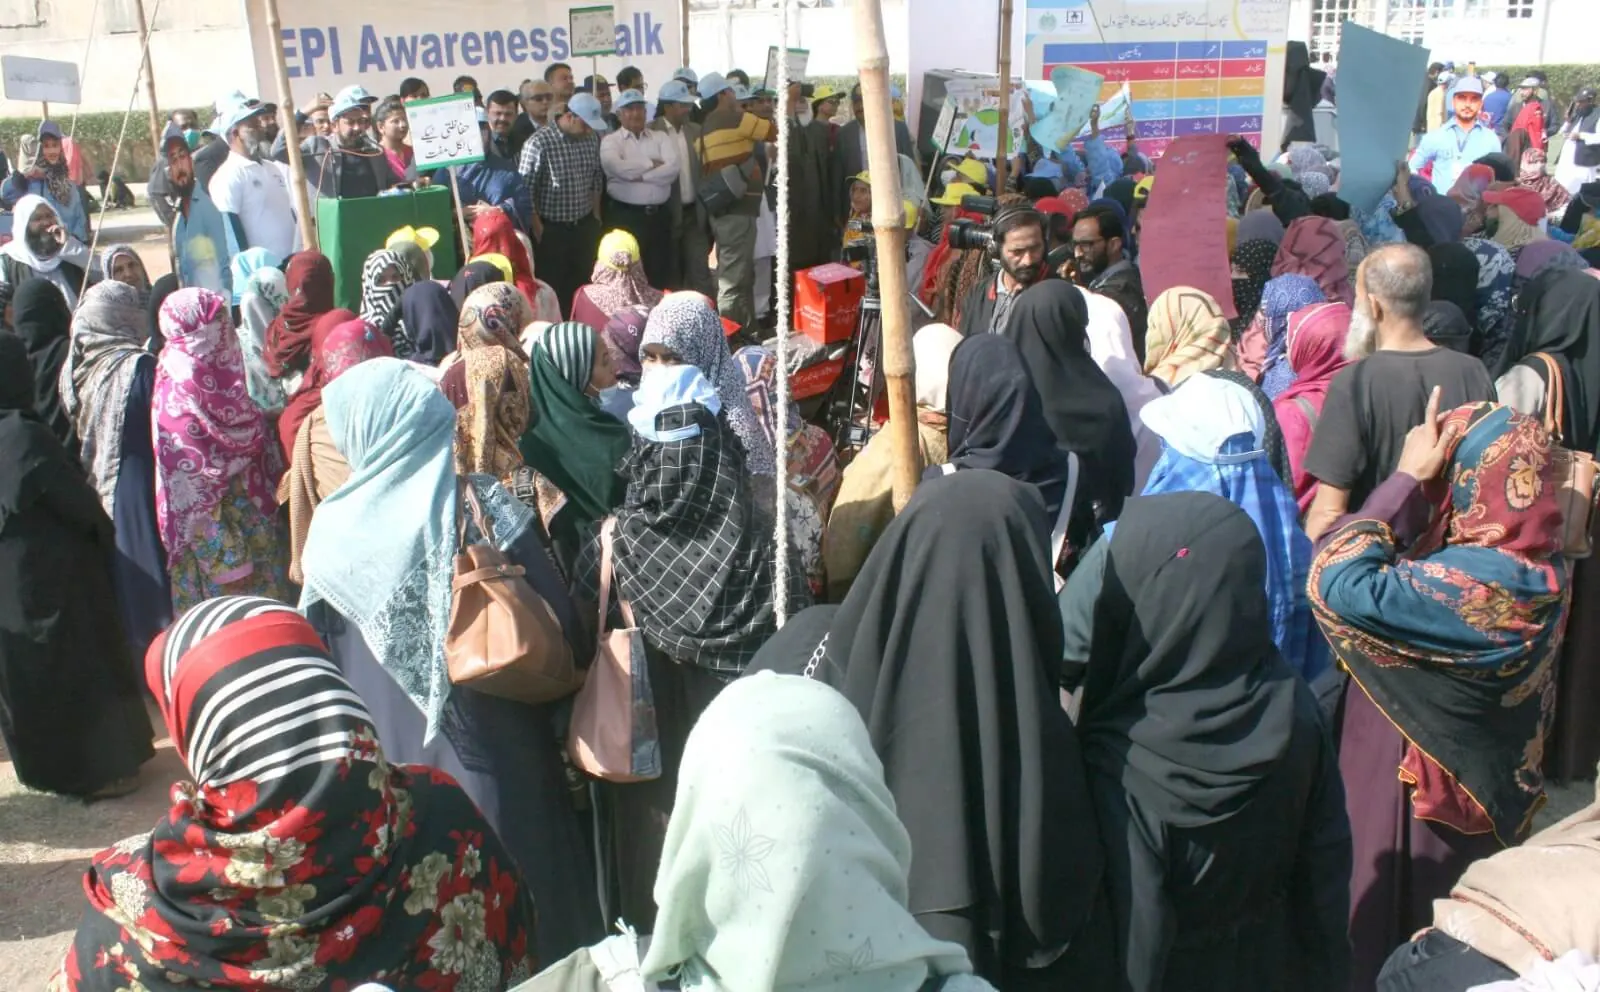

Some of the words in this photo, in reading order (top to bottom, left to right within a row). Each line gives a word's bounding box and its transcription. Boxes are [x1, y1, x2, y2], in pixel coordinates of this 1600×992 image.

[281, 27, 343, 77] EPI
[358, 24, 570, 73] Awareness
[613, 12, 665, 57] alk
